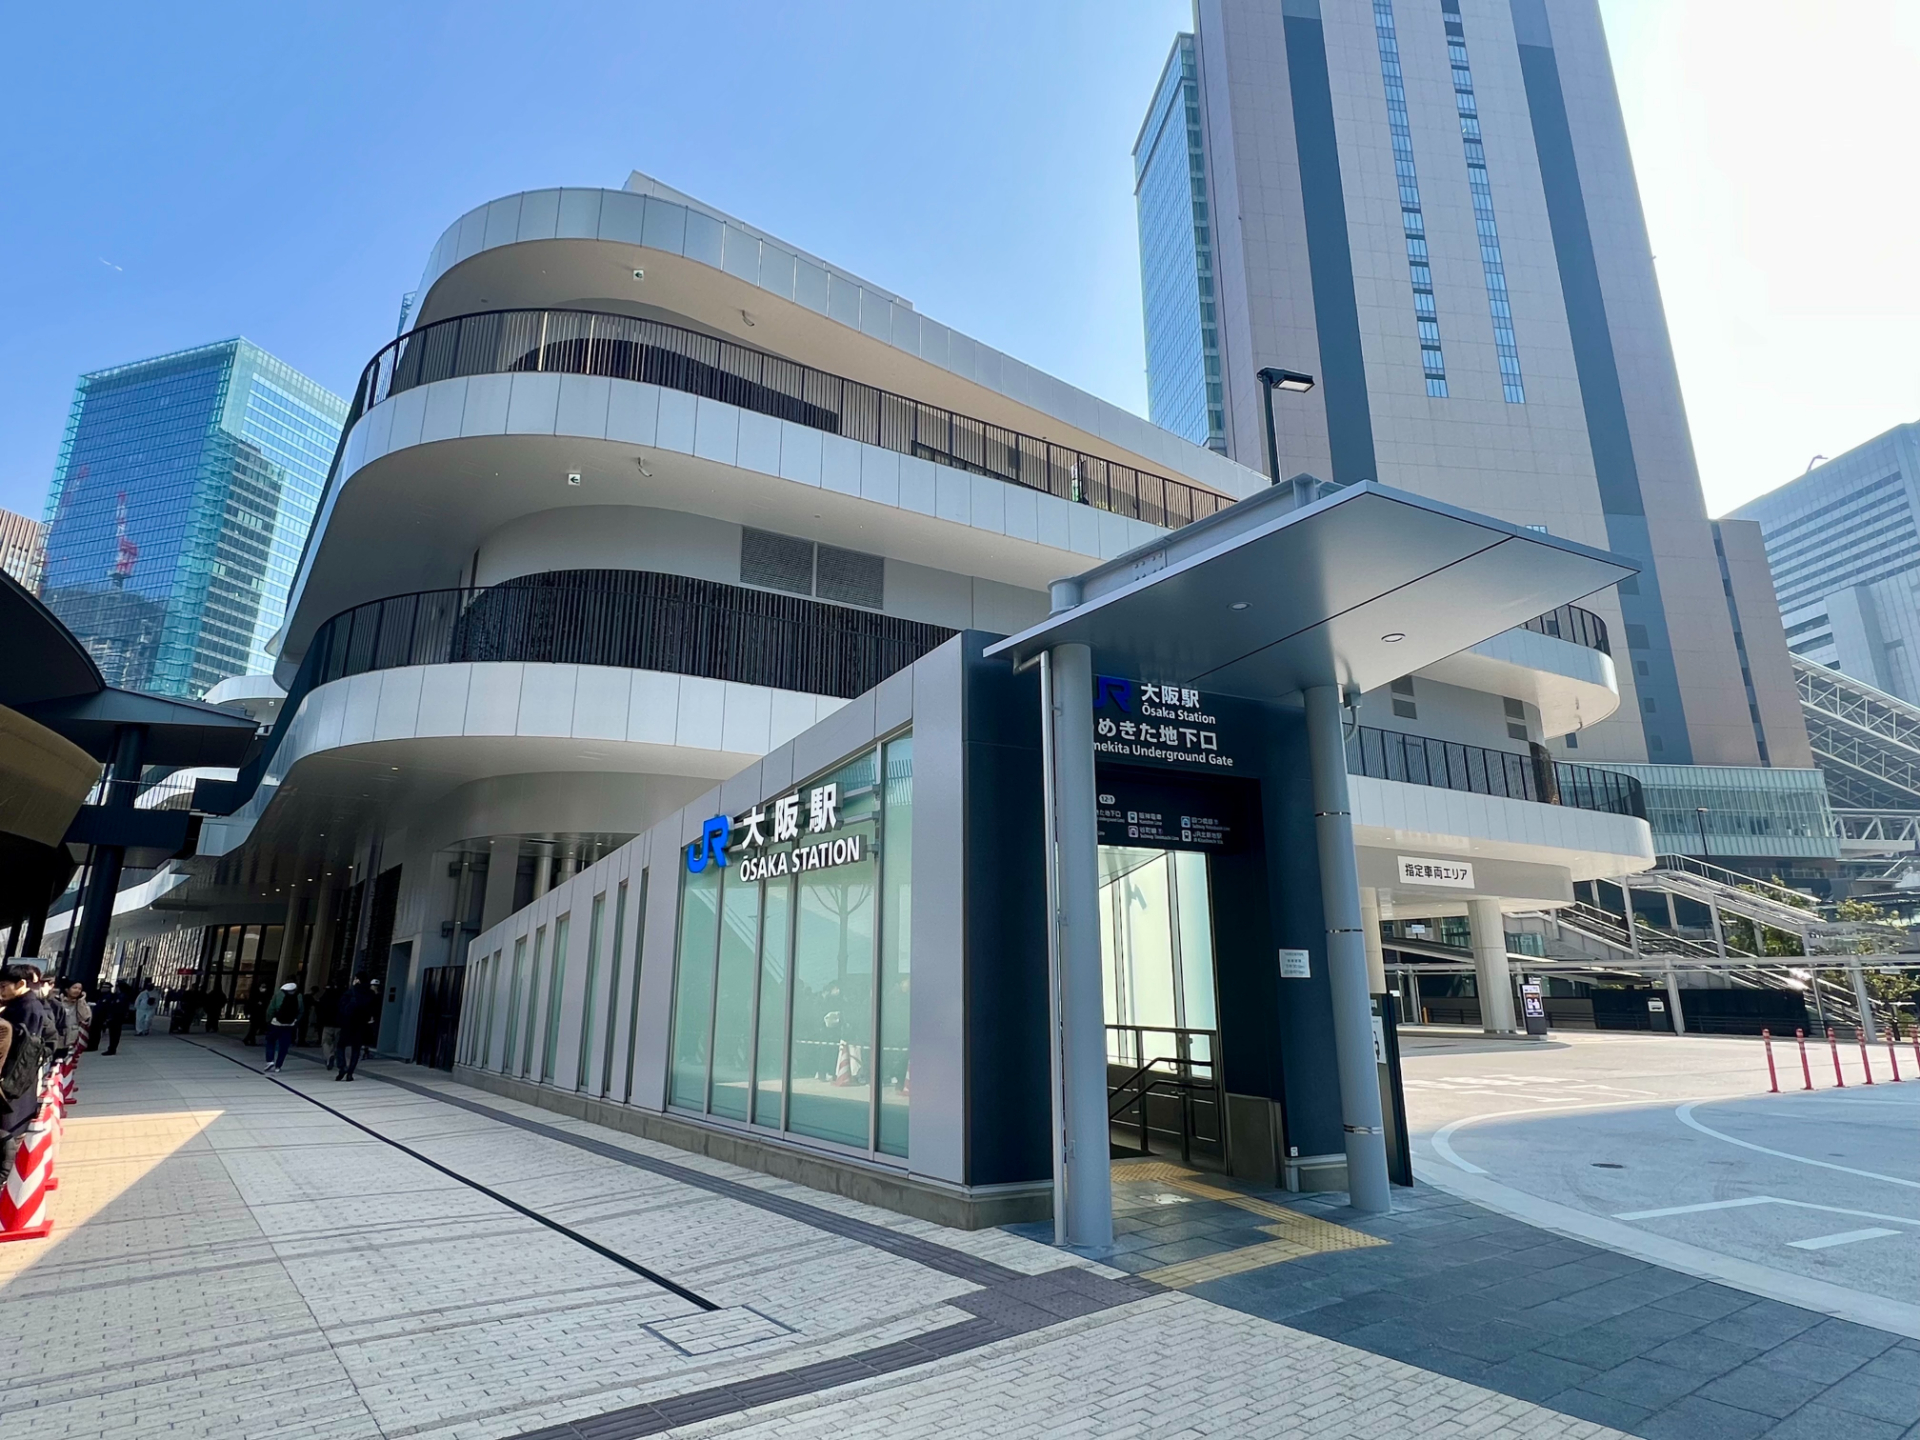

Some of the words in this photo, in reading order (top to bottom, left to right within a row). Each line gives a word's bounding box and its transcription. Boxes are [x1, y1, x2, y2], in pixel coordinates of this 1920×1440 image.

[1093, 675, 1131, 713] JR
[1141, 683, 1199, 708] 大阪駅
[1141, 702, 1175, 720] Ōsaka
[1178, 711, 1216, 725] Station
[1098, 718, 1218, 750] めきた地下口
[1093, 741, 1130, 755] mekita
[1132, 745, 1206, 763] Underground
[1208, 754, 1233, 766] Gate
[742, 782, 837, 849] 大阪駅
[687, 815, 729, 873] JR
[740, 852, 788, 882] ŌSAKA
[792, 835, 860, 873] STATION
[1405, 863, 1468, 881] 指定車両エリア
